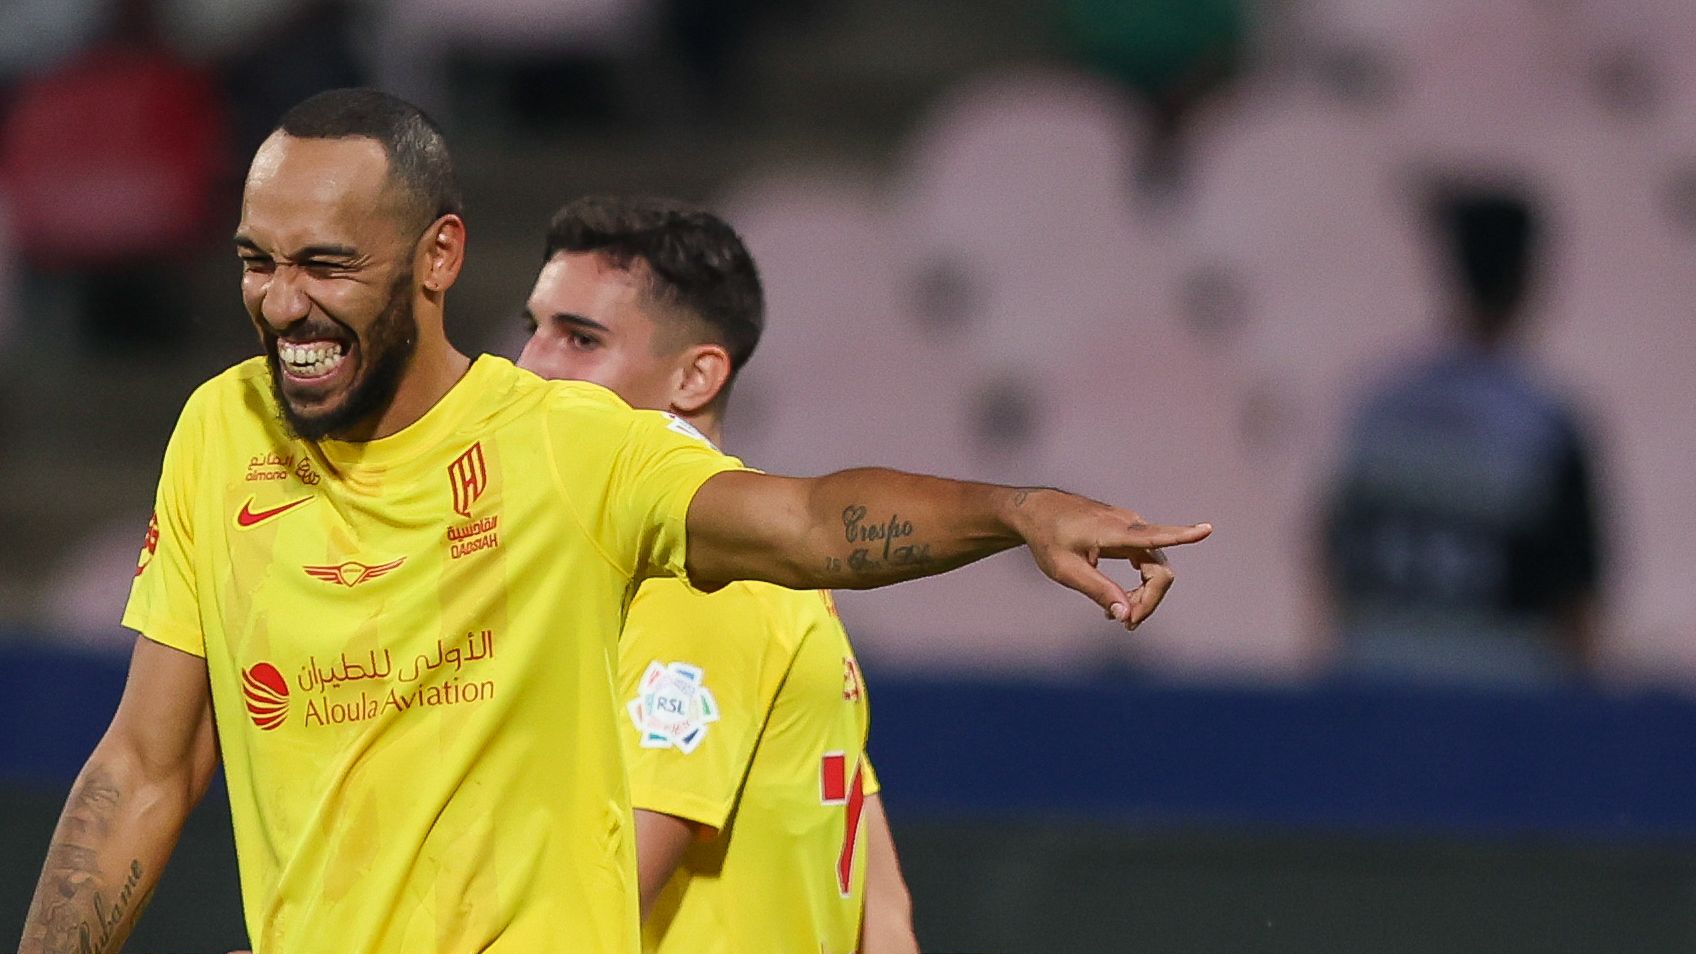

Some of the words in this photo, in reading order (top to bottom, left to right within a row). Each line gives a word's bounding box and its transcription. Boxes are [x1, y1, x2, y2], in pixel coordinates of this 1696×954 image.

[842, 505, 913, 560] Crespo
[304, 691, 379, 729] Aloula
[380, 677, 495, 716] Aviation
[657, 695, 685, 716] RSL
